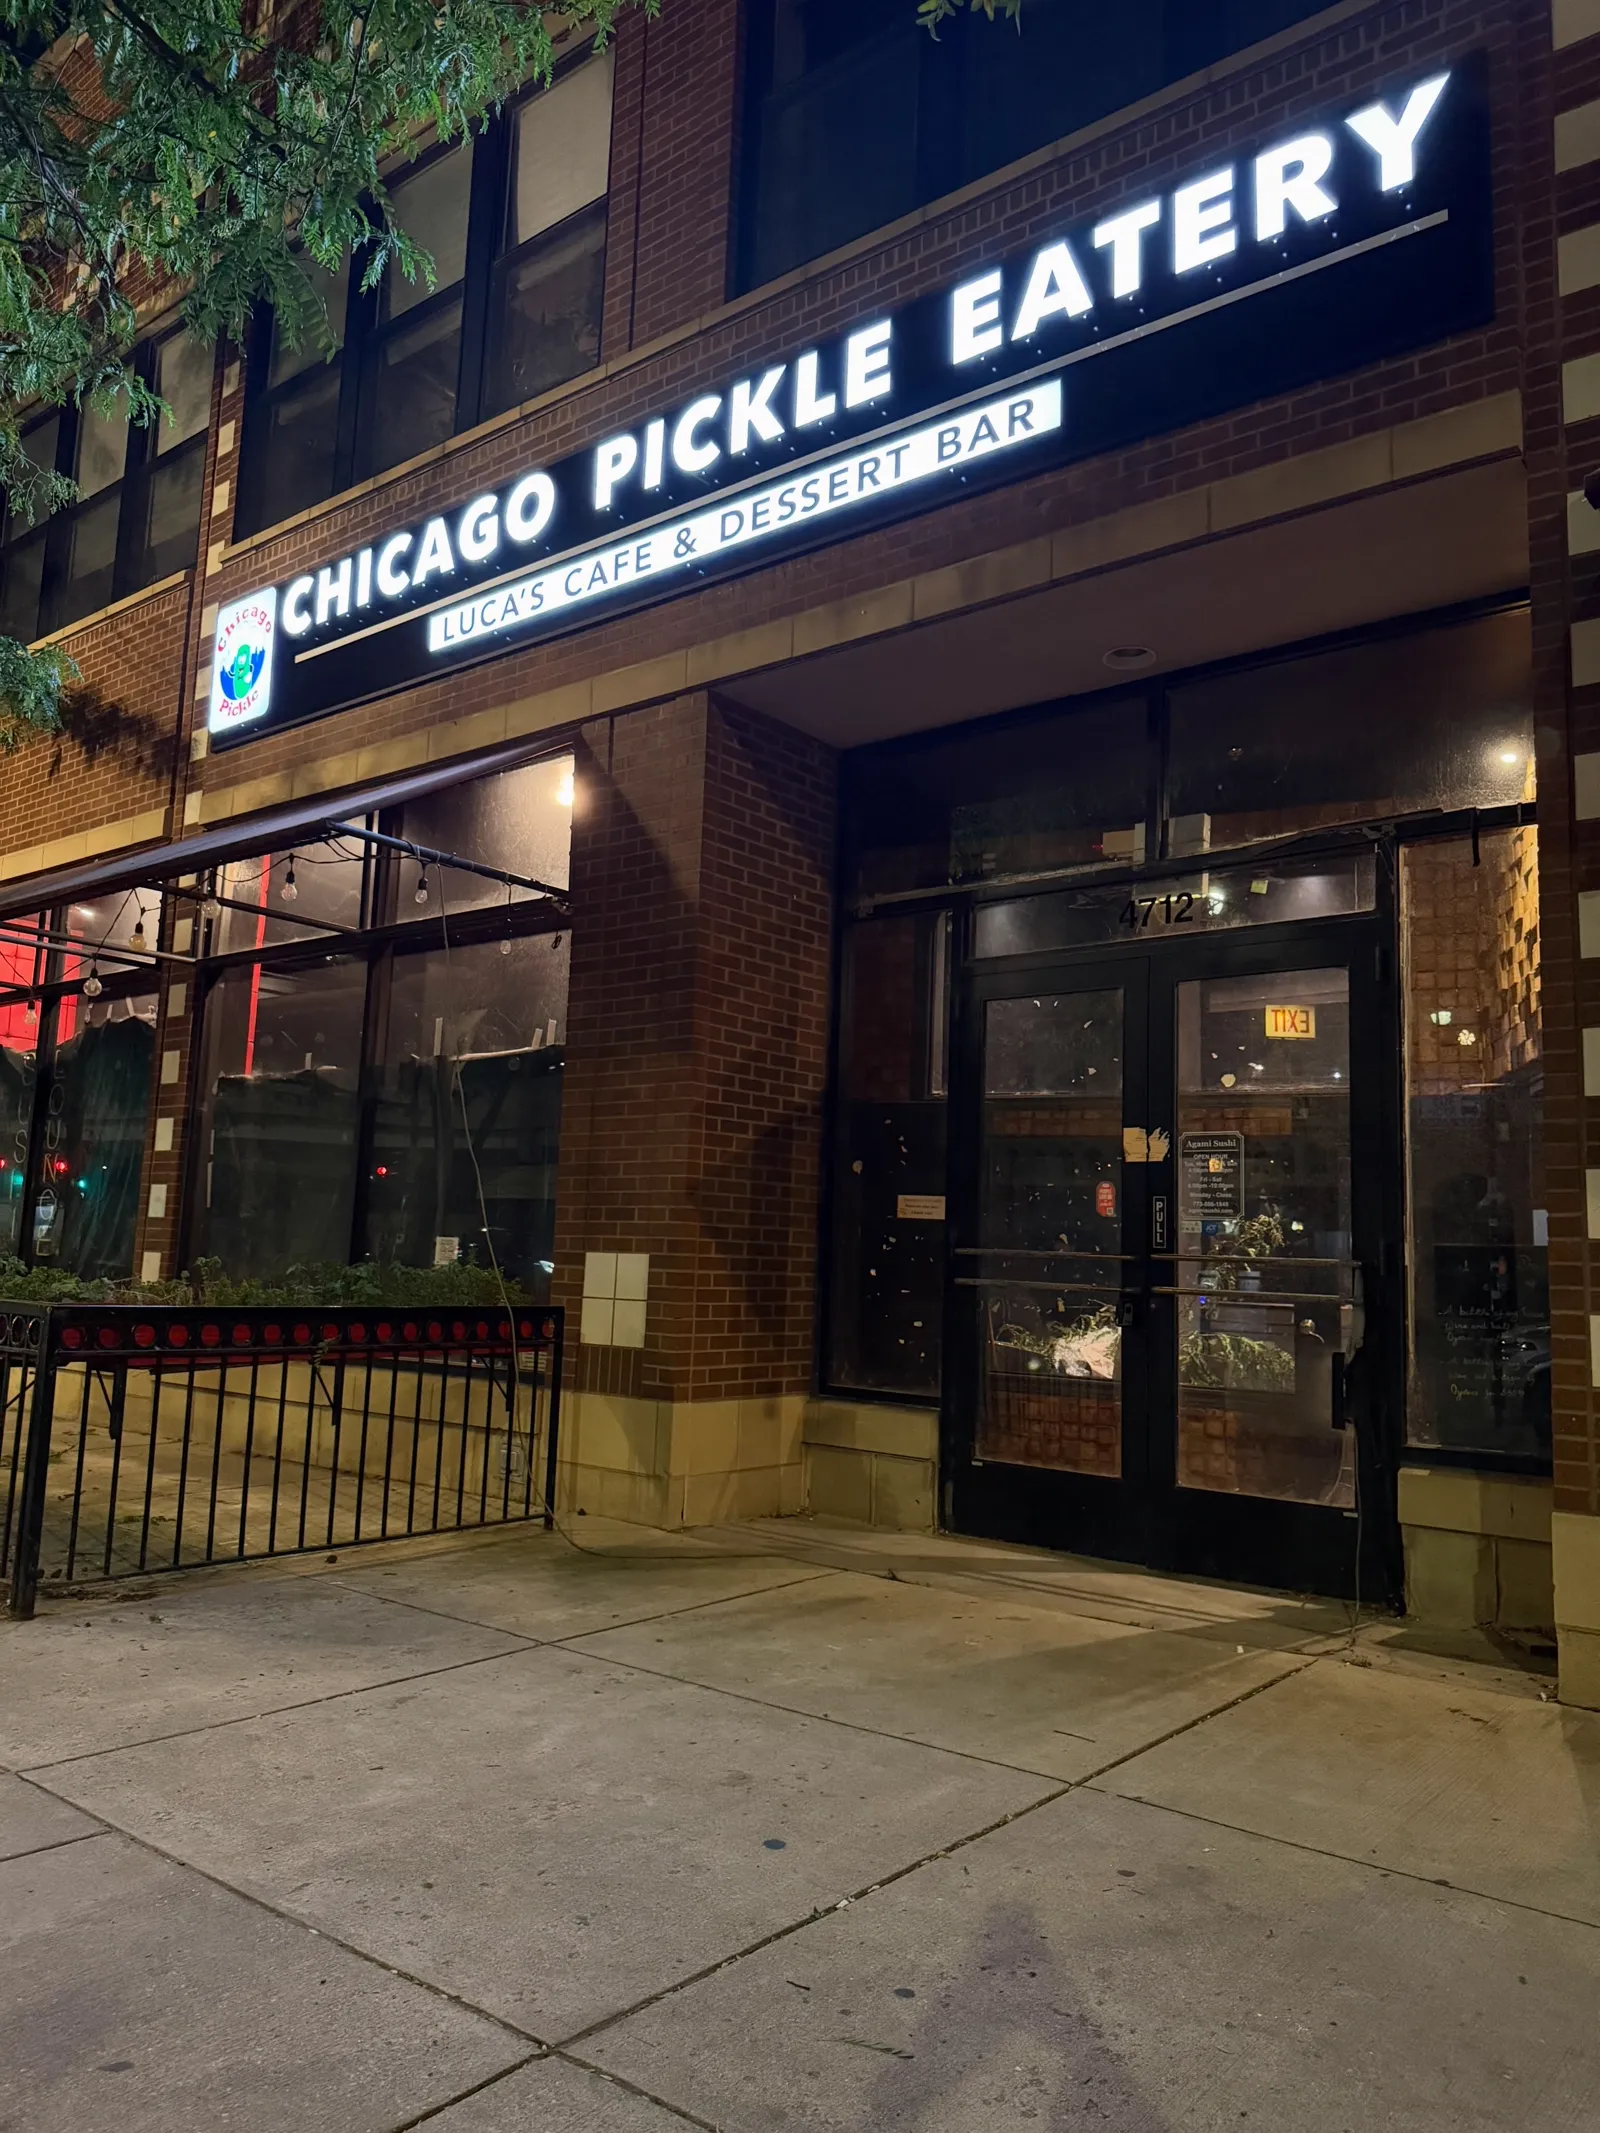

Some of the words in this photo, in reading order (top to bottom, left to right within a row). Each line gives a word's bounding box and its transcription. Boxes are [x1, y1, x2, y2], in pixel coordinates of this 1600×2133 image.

[282, 473, 556, 634] CHICAGO
[594, 319, 892, 510] PICKLE
[952, 72, 1451, 365] EATERY
[443, 582, 544, 641] LUCA'S
[566, 542, 652, 597] CAFE
[673, 528, 698, 558] &
[721, 443, 910, 541] DESSERT
[937, 398, 1035, 463] BAR
[218, 607, 272, 652] Chicago
[1119, 892, 1194, 929] 4712
[1186, 1140, 1212, 1148] Agami
[1155, 1201, 1163, 1243] PULL
